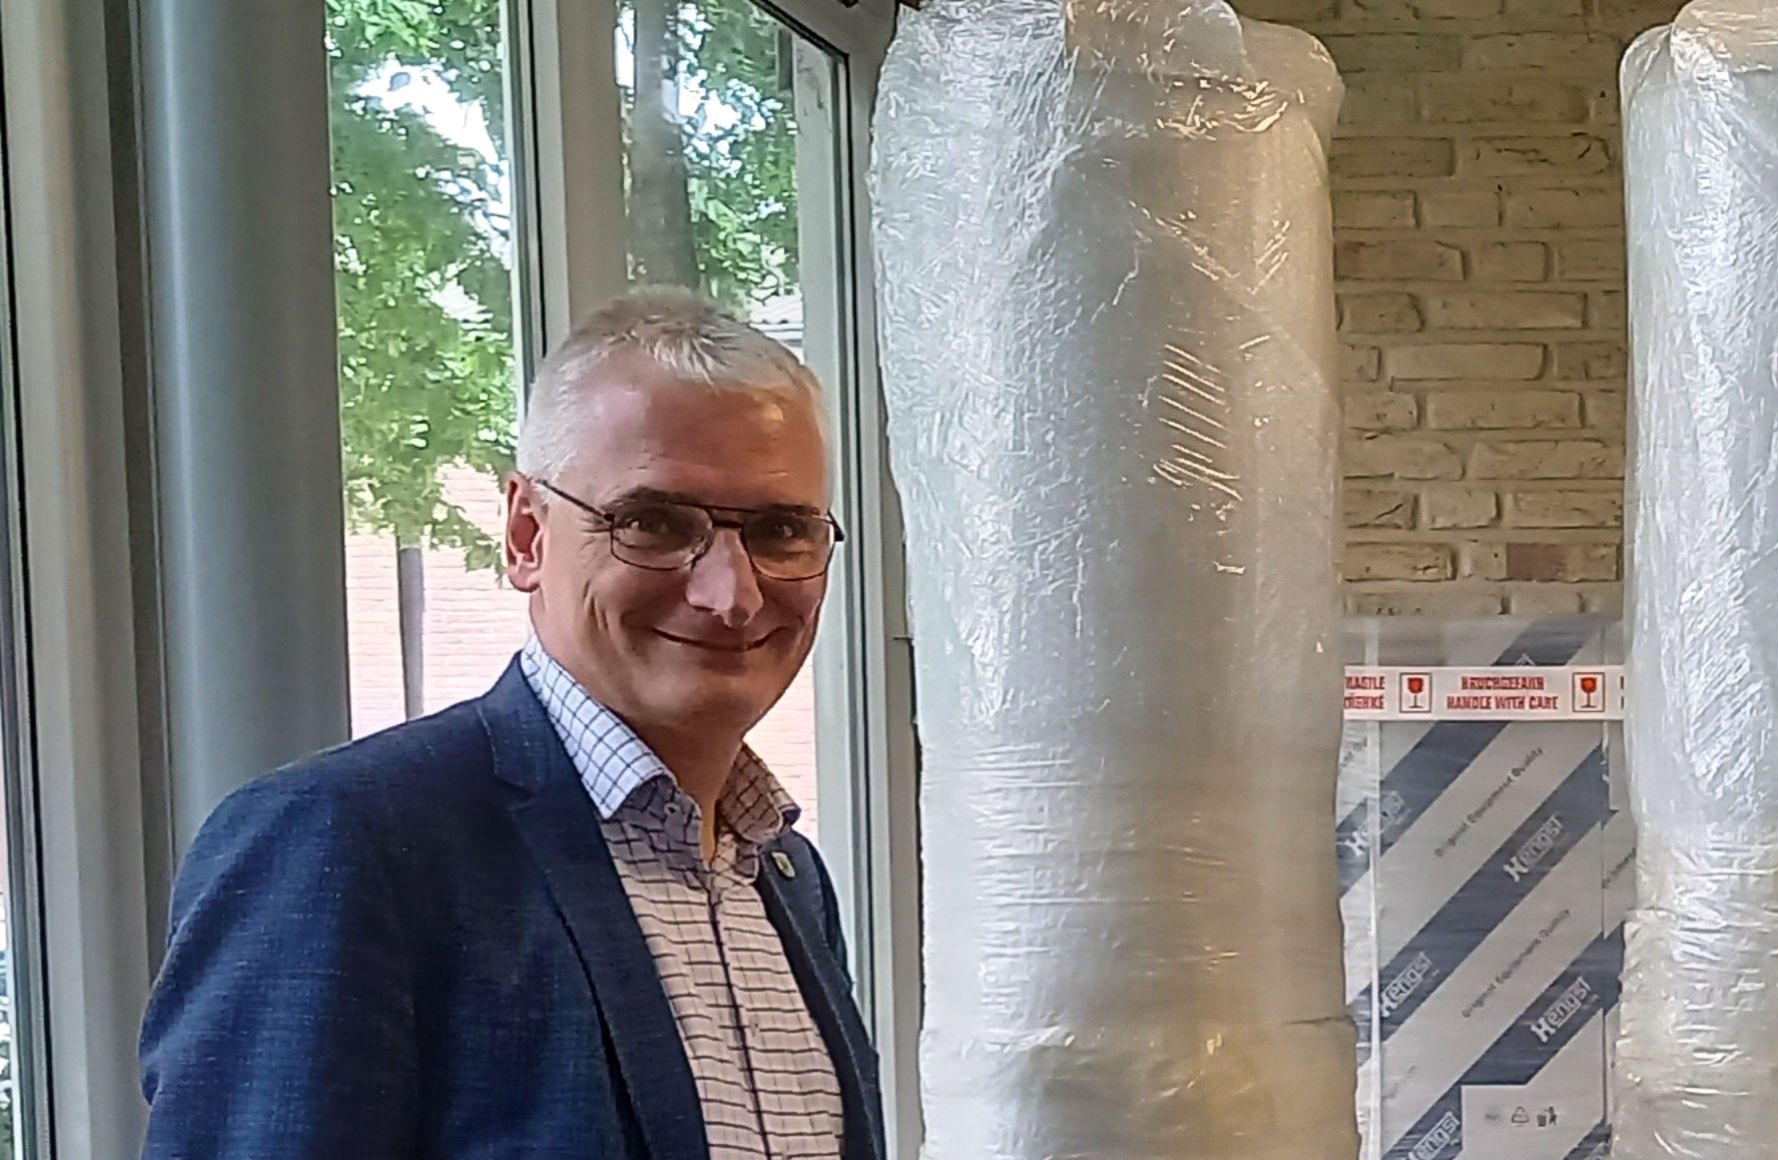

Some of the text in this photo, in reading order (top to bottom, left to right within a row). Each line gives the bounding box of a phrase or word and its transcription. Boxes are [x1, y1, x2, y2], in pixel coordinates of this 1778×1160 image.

[1446, 695, 1559, 710] HANDLE WITH CARE
[1531, 976, 1592, 1043] Hengst
